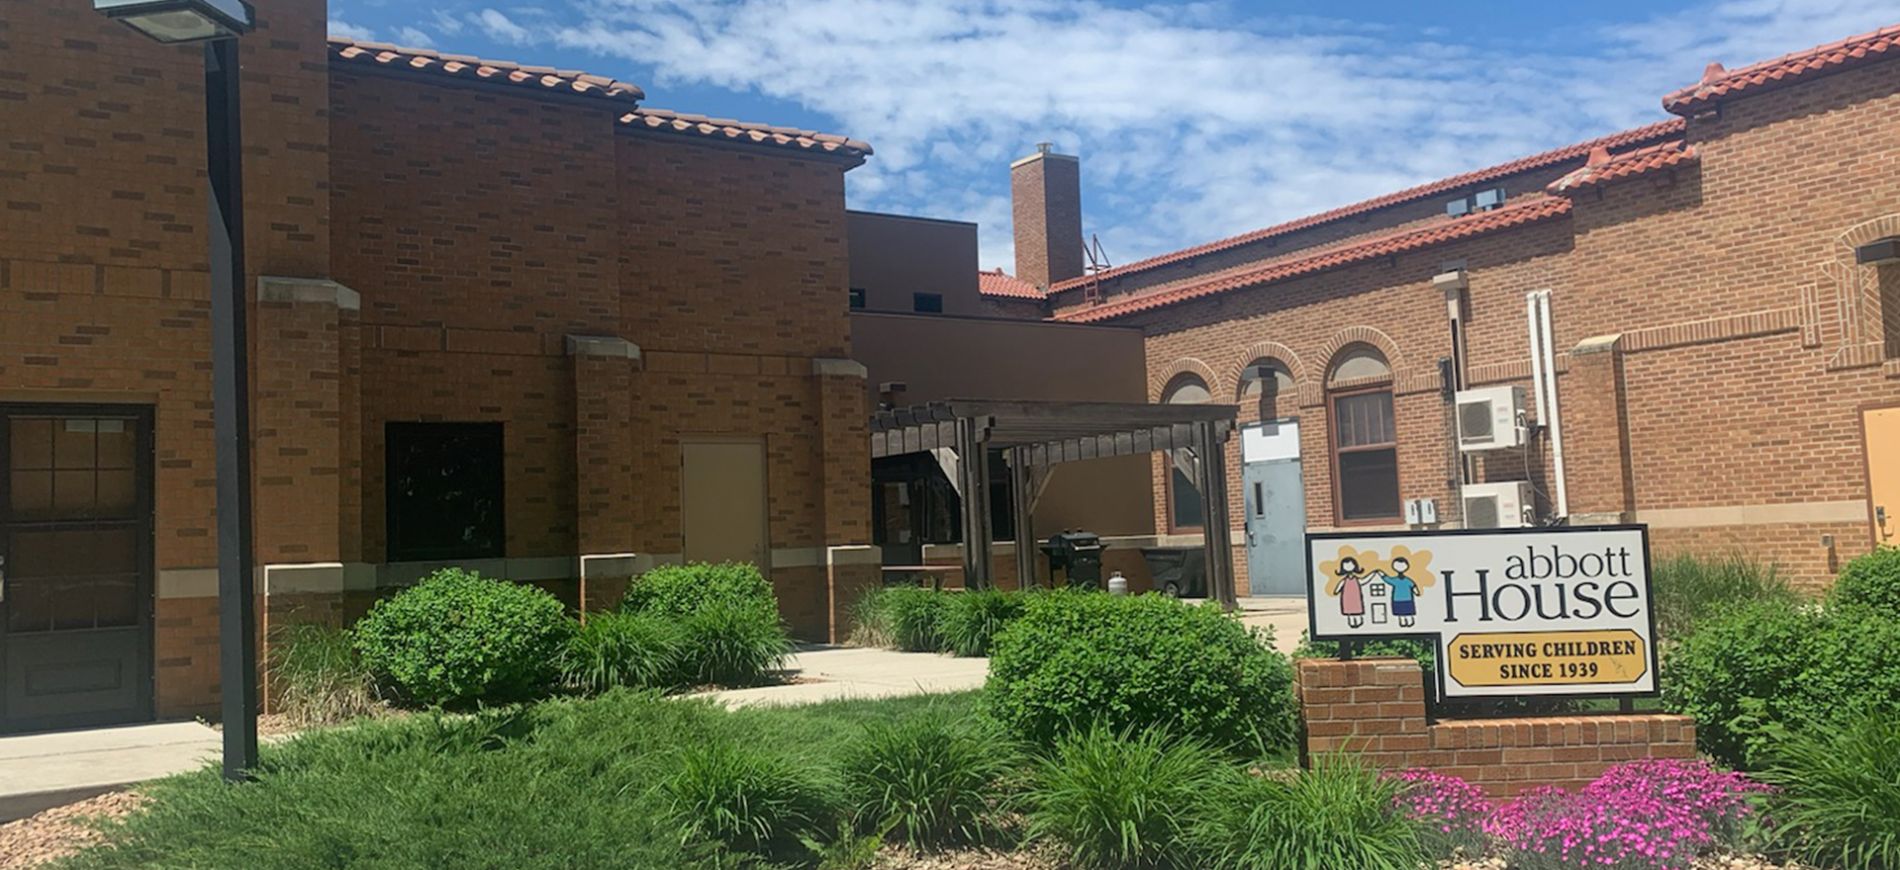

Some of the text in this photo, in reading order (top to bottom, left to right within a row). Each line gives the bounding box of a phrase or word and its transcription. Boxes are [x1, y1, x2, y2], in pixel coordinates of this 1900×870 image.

[1505, 545, 1632, 580] abbott
[1441, 569, 1640, 622] House
[1459, 640, 1636, 659] SERVING CHILDREN
[1500, 662, 1599, 679] SINCE 1939
